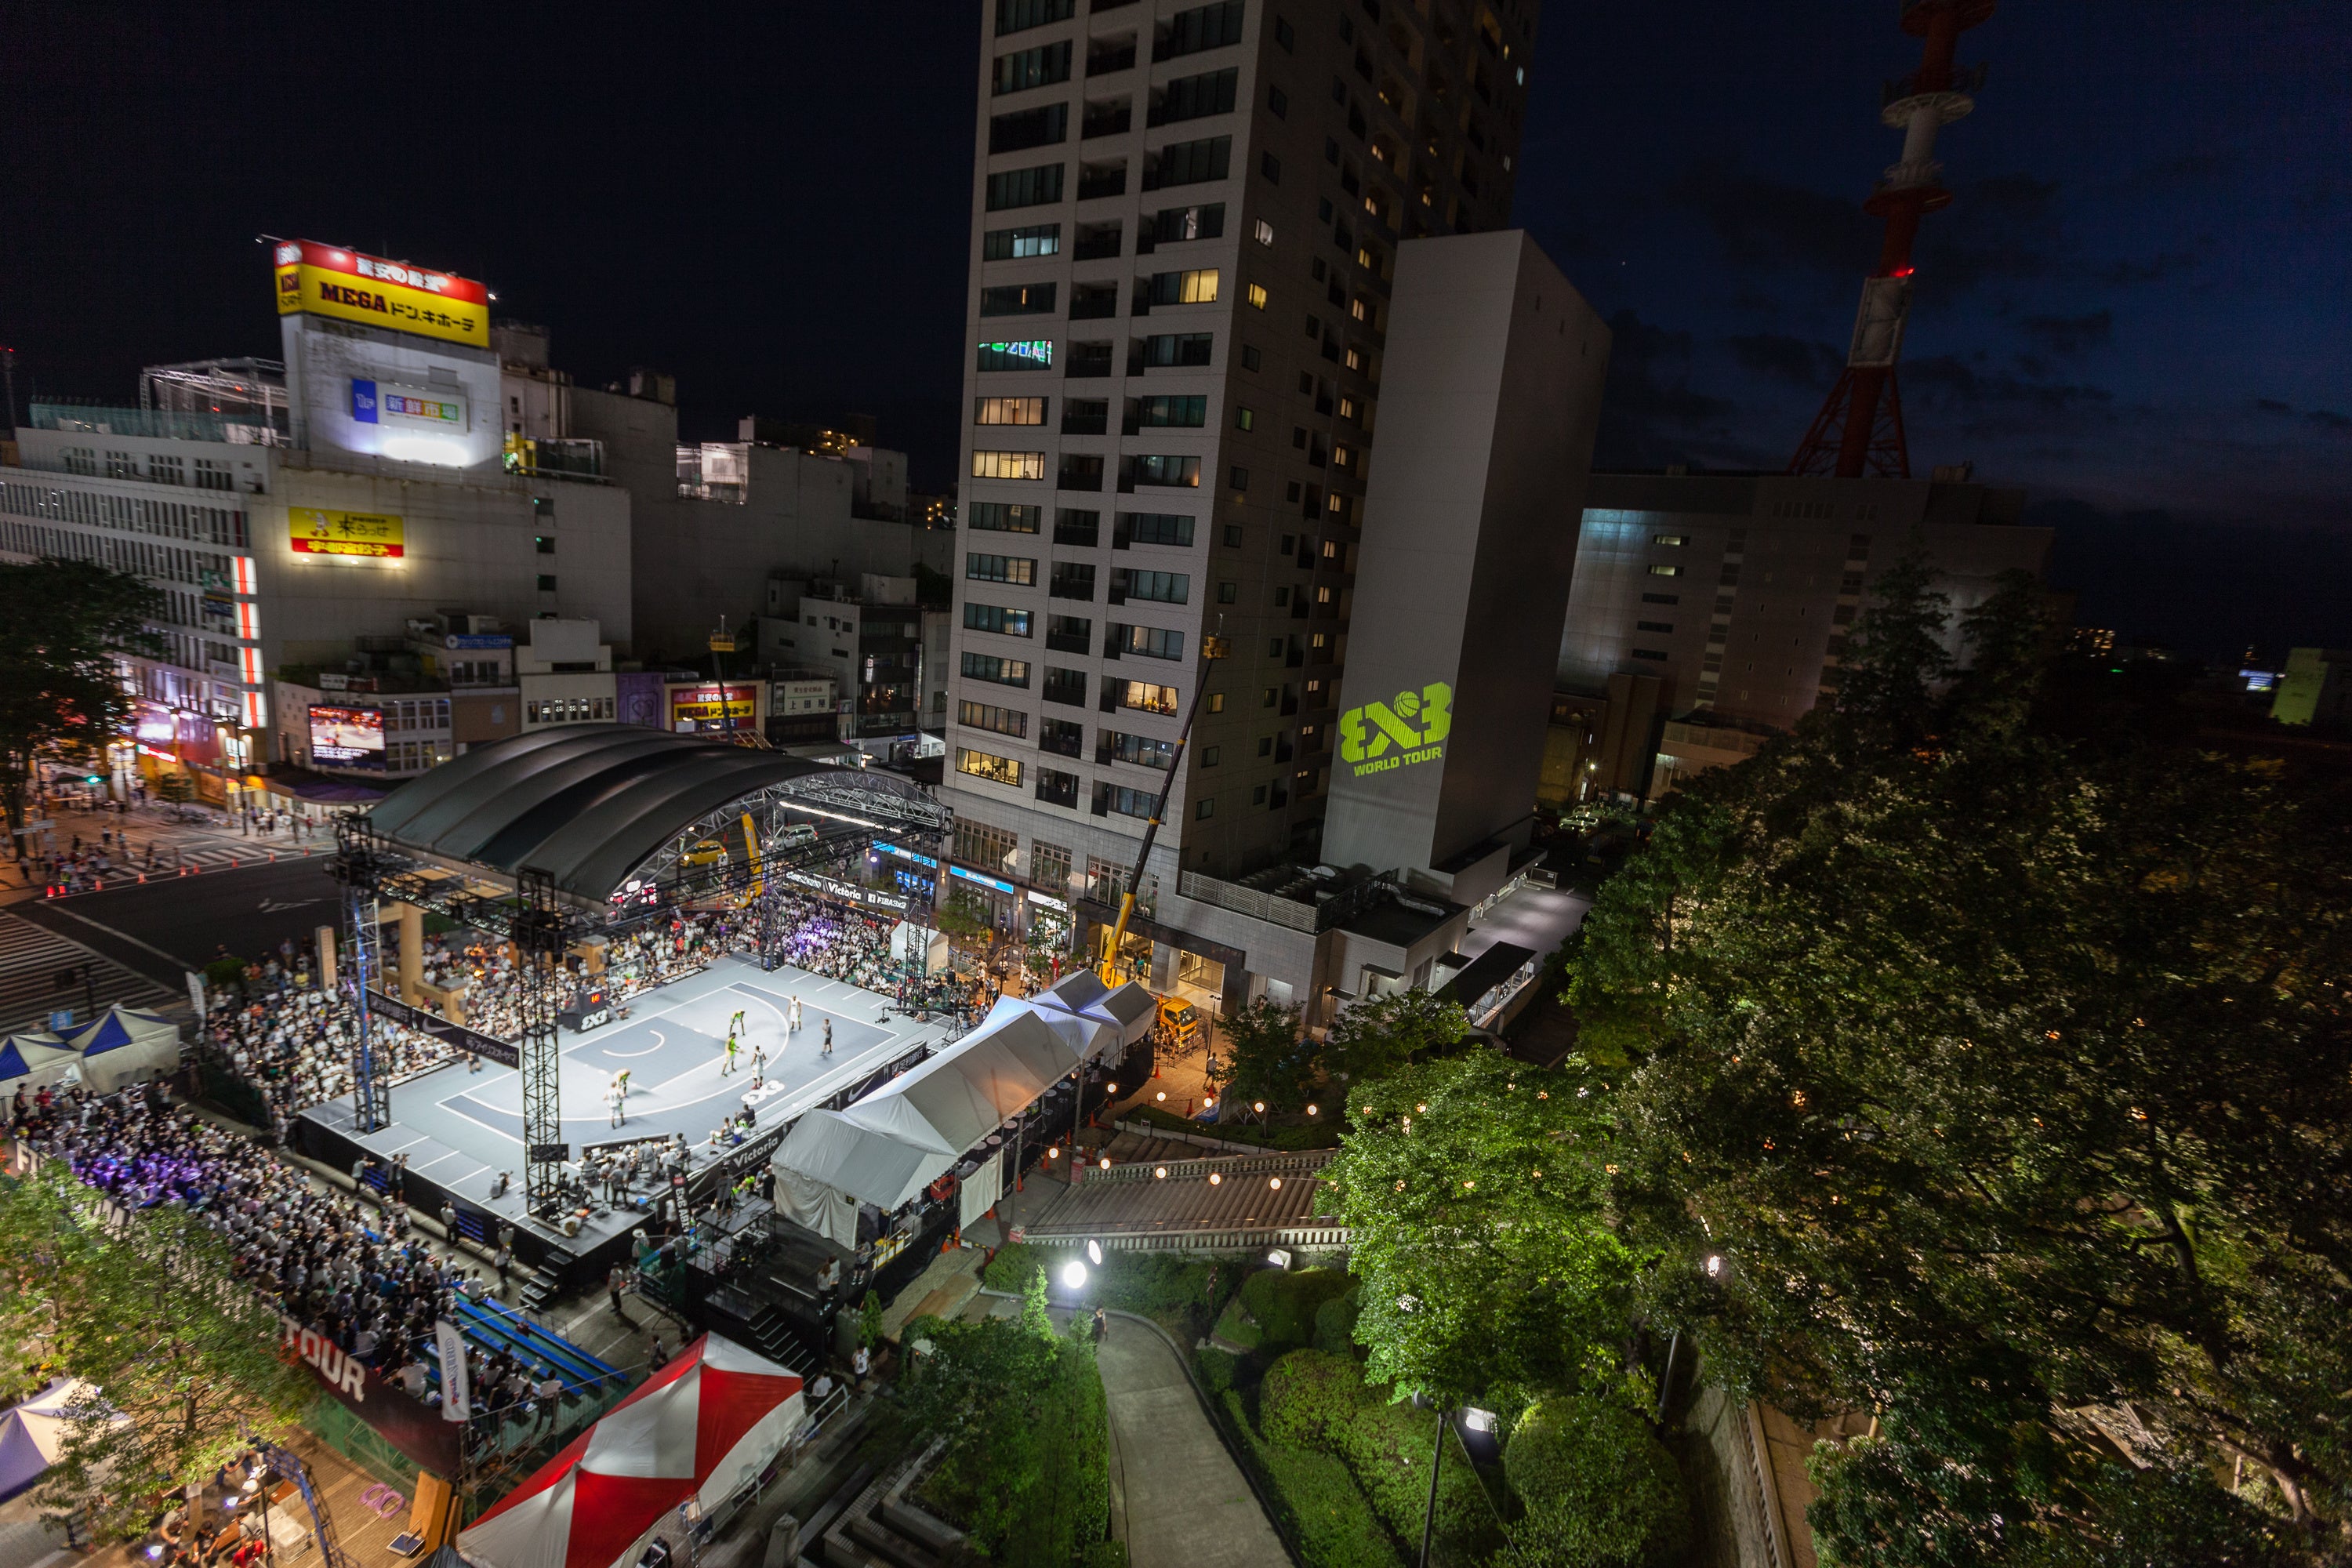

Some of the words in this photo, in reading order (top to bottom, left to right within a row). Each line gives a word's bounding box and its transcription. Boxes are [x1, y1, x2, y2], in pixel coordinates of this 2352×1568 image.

[319, 281, 389, 314] MEGA
[387, 395, 457, 420] 新鮮市場
[1354, 756, 1399, 777] WORLD
[1403, 746, 1442, 765] TOUR
[828, 882, 862, 900] Victoria
[734, 1136, 779, 1167] Victoria
[281, 1315, 366, 1403] TOUR
